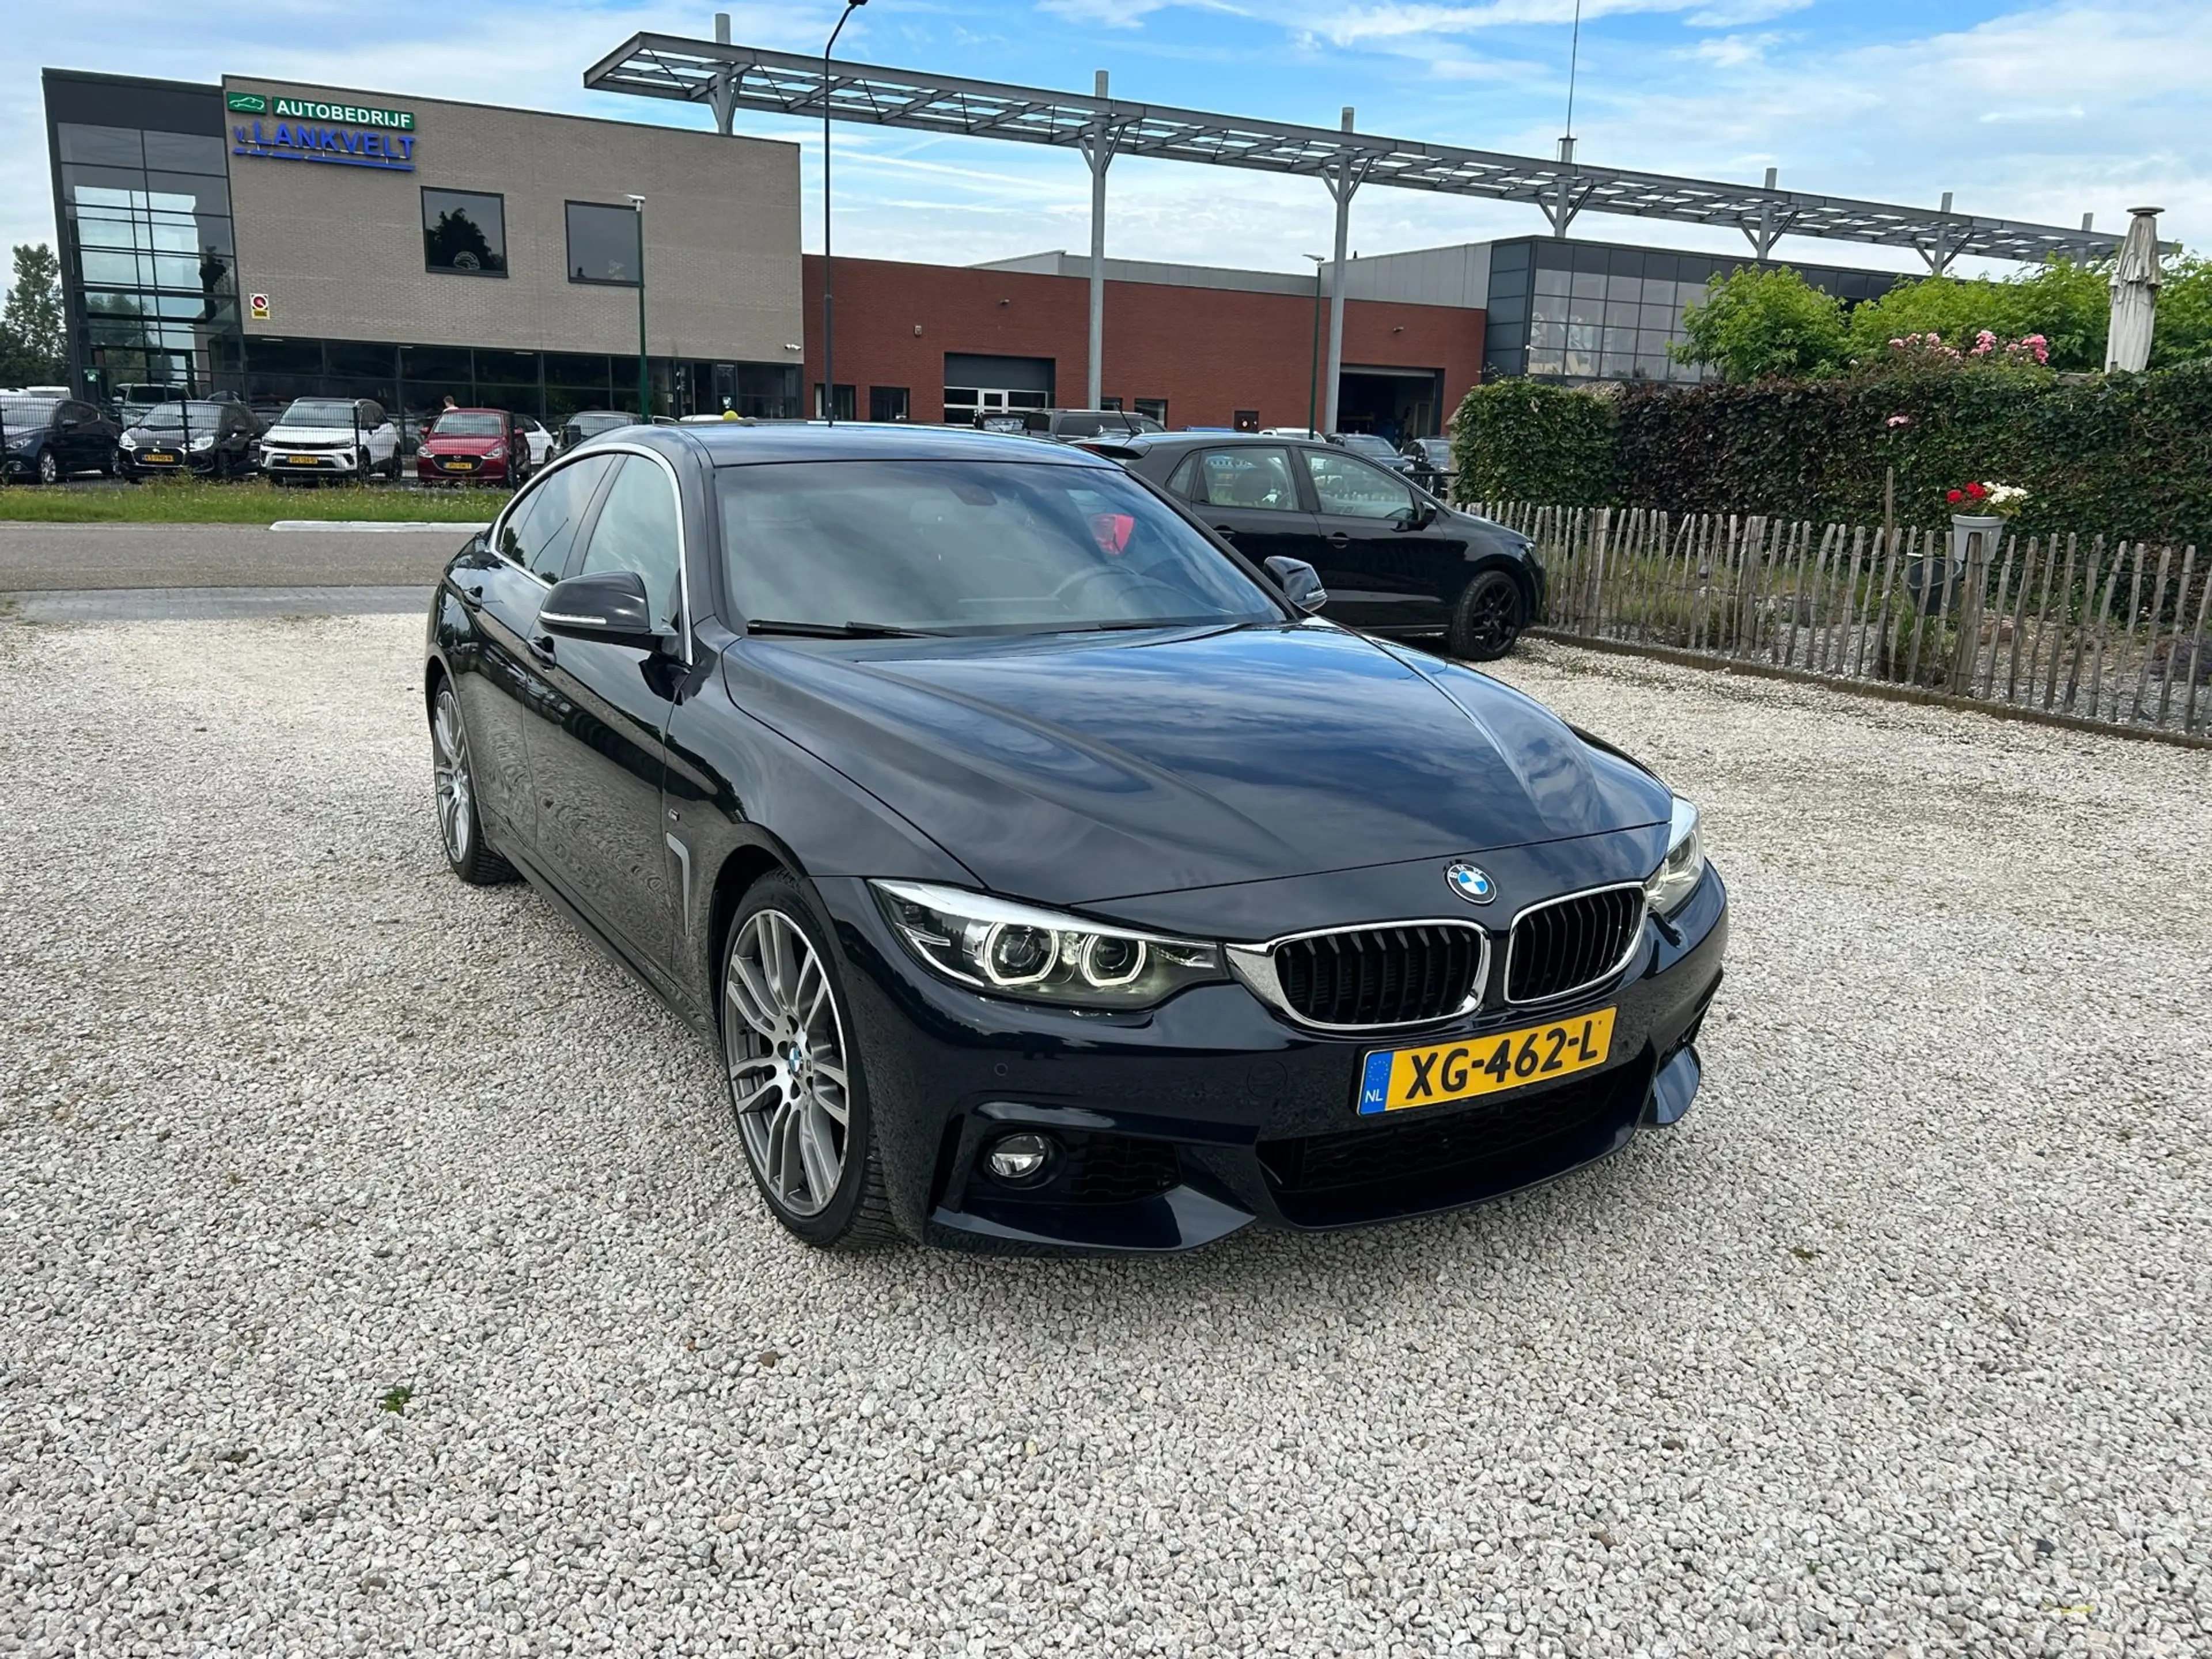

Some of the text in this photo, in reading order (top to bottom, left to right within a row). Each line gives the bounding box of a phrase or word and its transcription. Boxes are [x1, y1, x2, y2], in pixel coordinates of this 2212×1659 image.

[276, 100, 412, 127] AUTOBEDRIJF
[253, 120, 415, 160] LANKVELT
[1449, 864, 1483, 879] BMW
[1406, 1020, 1597, 1100] XG-462-L
[1365, 1090, 1383, 1104] NL
